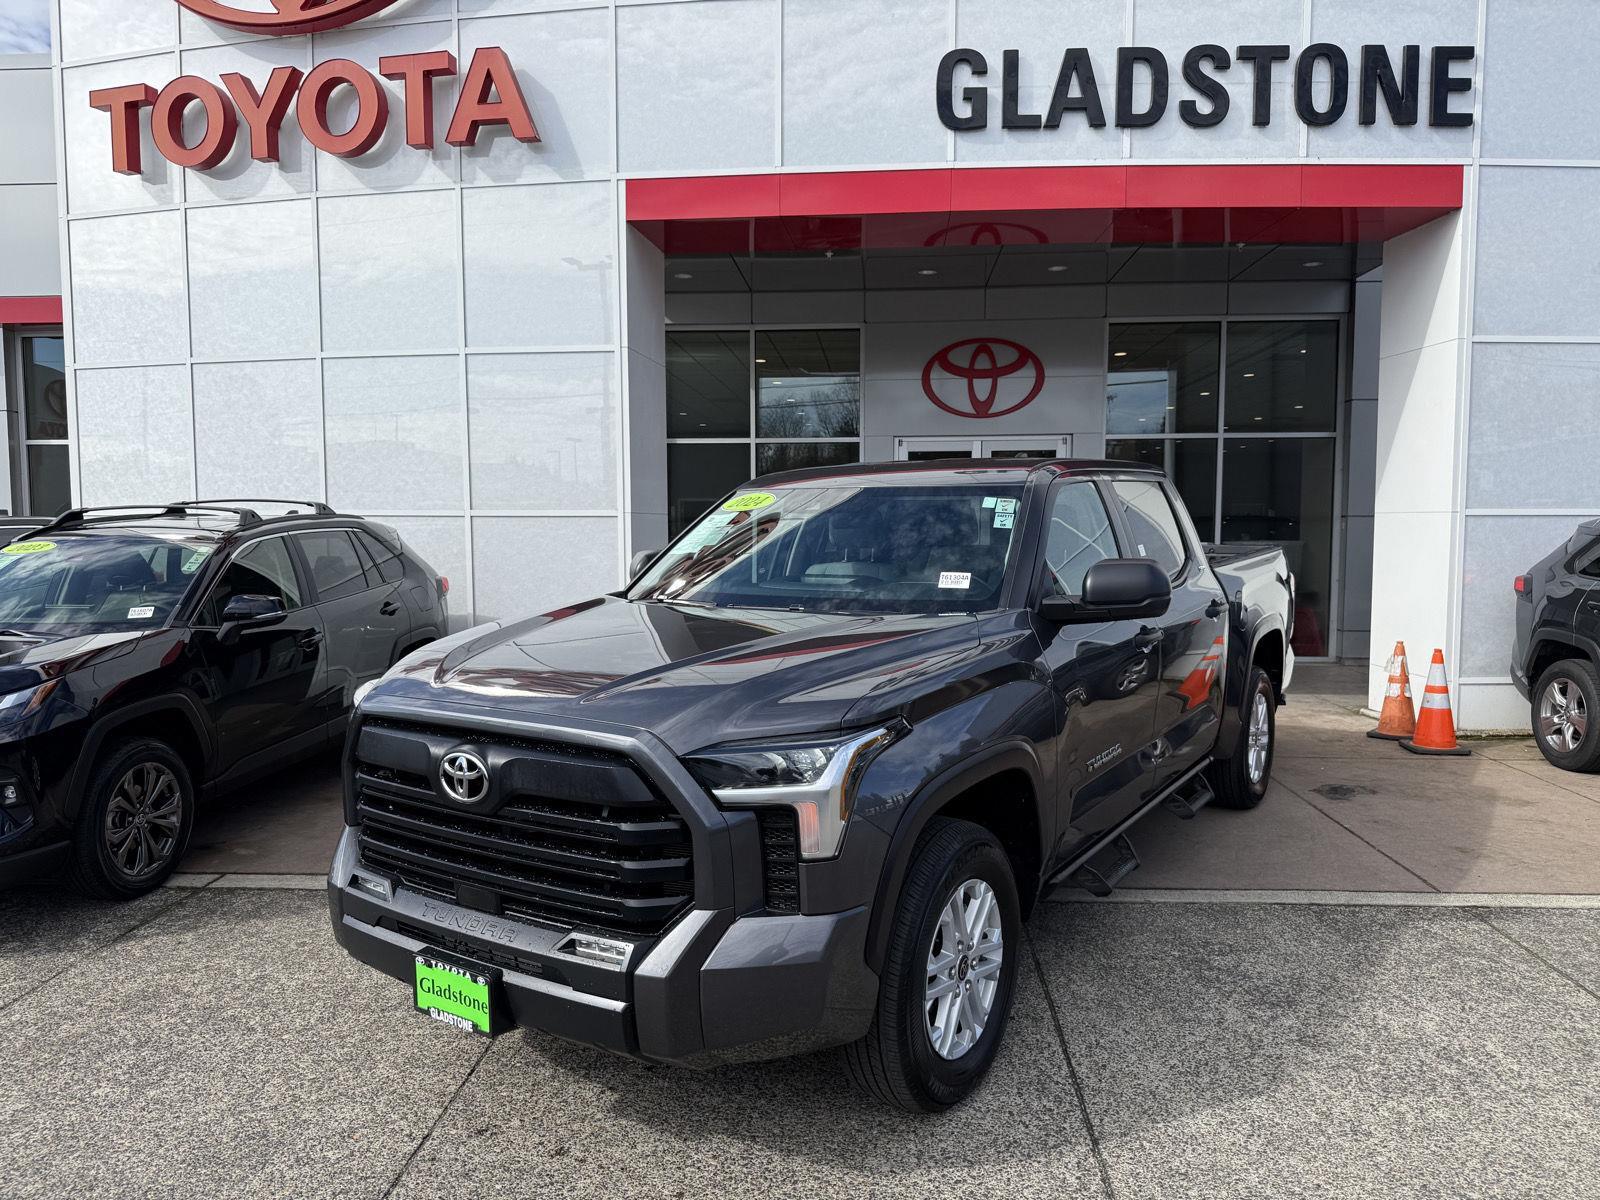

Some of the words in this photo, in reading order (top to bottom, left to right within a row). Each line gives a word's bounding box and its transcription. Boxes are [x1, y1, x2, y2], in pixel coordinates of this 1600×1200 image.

[936, 43, 1475, 131] GLADSTONE
[89, 46, 541, 176] TOYOTA
[422, 901, 519, 943] TUNDRA
[430, 960, 472, 981] TOYOTA
[419, 977, 488, 1015] Gladstone
[429, 1007, 474, 1032] GLADSTONE
